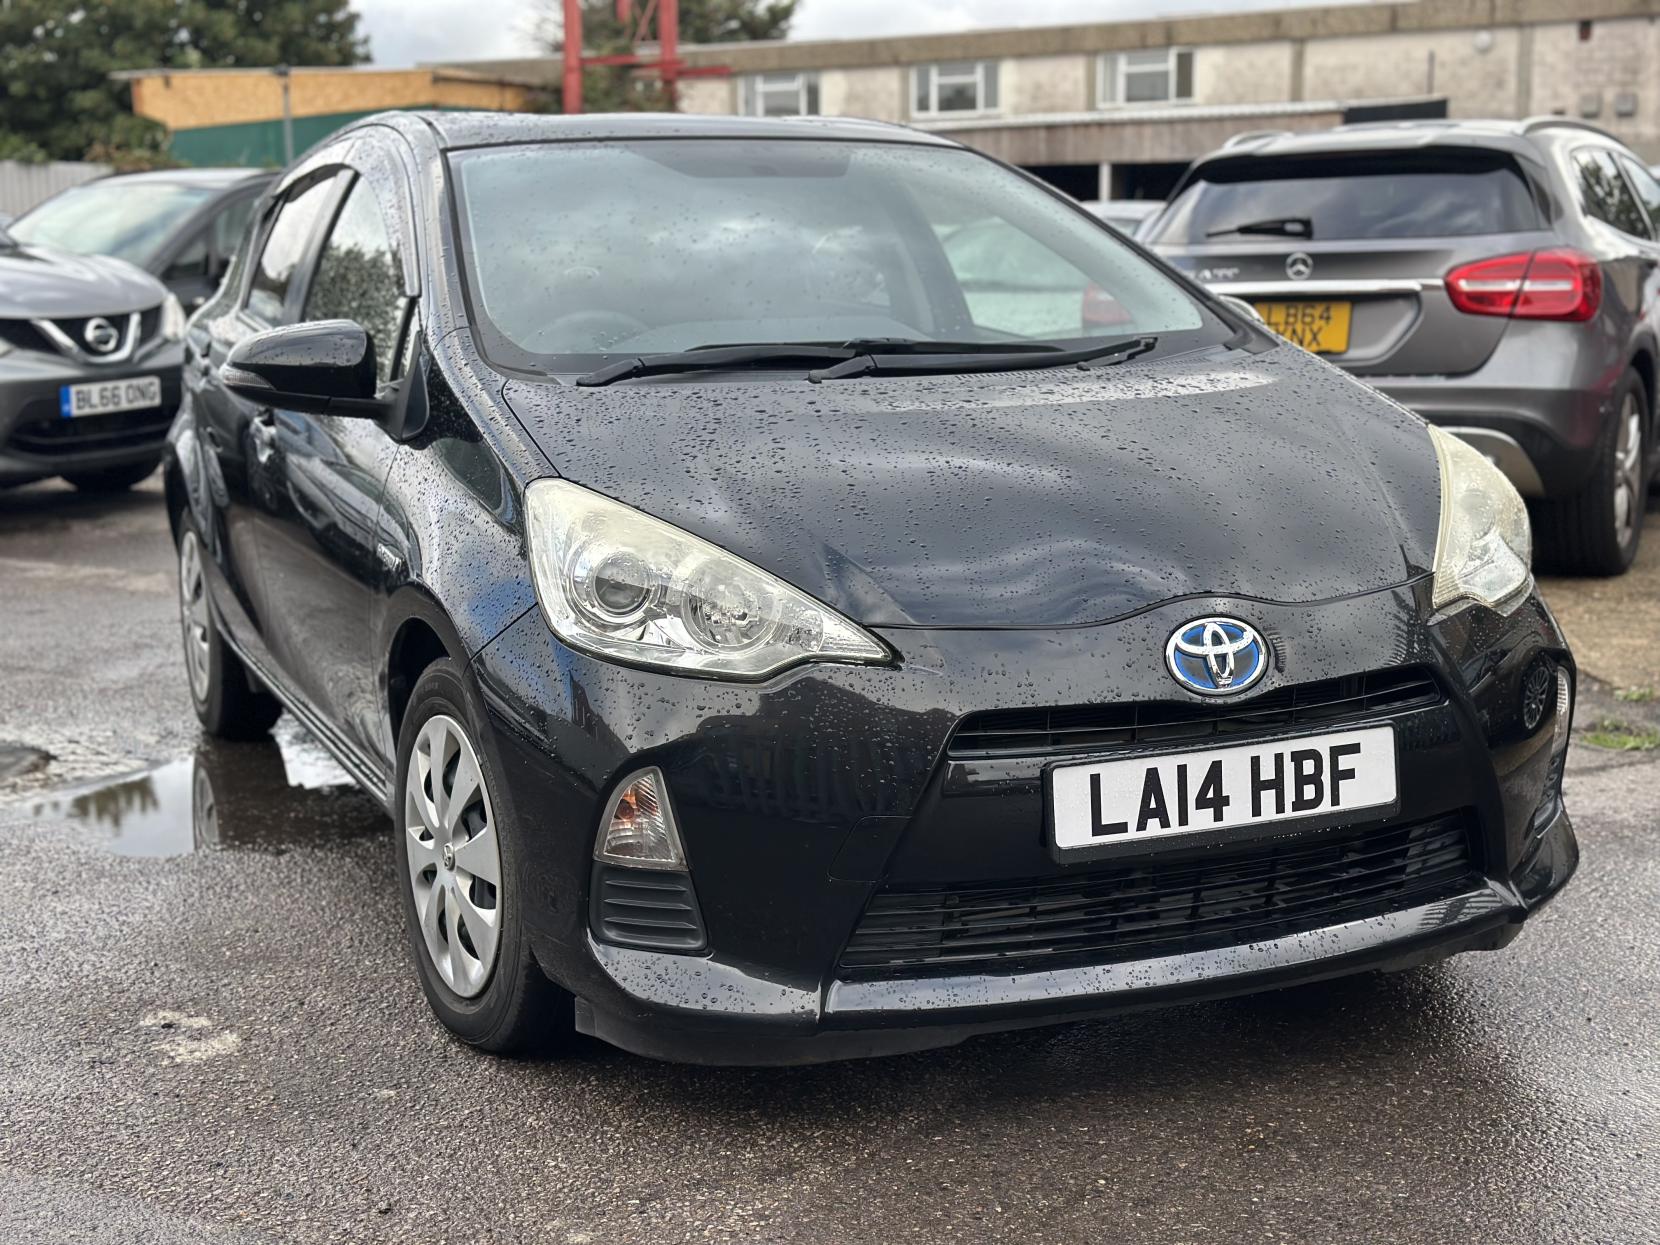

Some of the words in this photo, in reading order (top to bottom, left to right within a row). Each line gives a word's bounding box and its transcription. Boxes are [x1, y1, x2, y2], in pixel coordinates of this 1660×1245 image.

[1267, 303, 1331, 326] LB64
[76, 386, 122, 410] BL66
[1090, 760, 1230, 837] LA14
[1250, 742, 1361, 818] HBF
